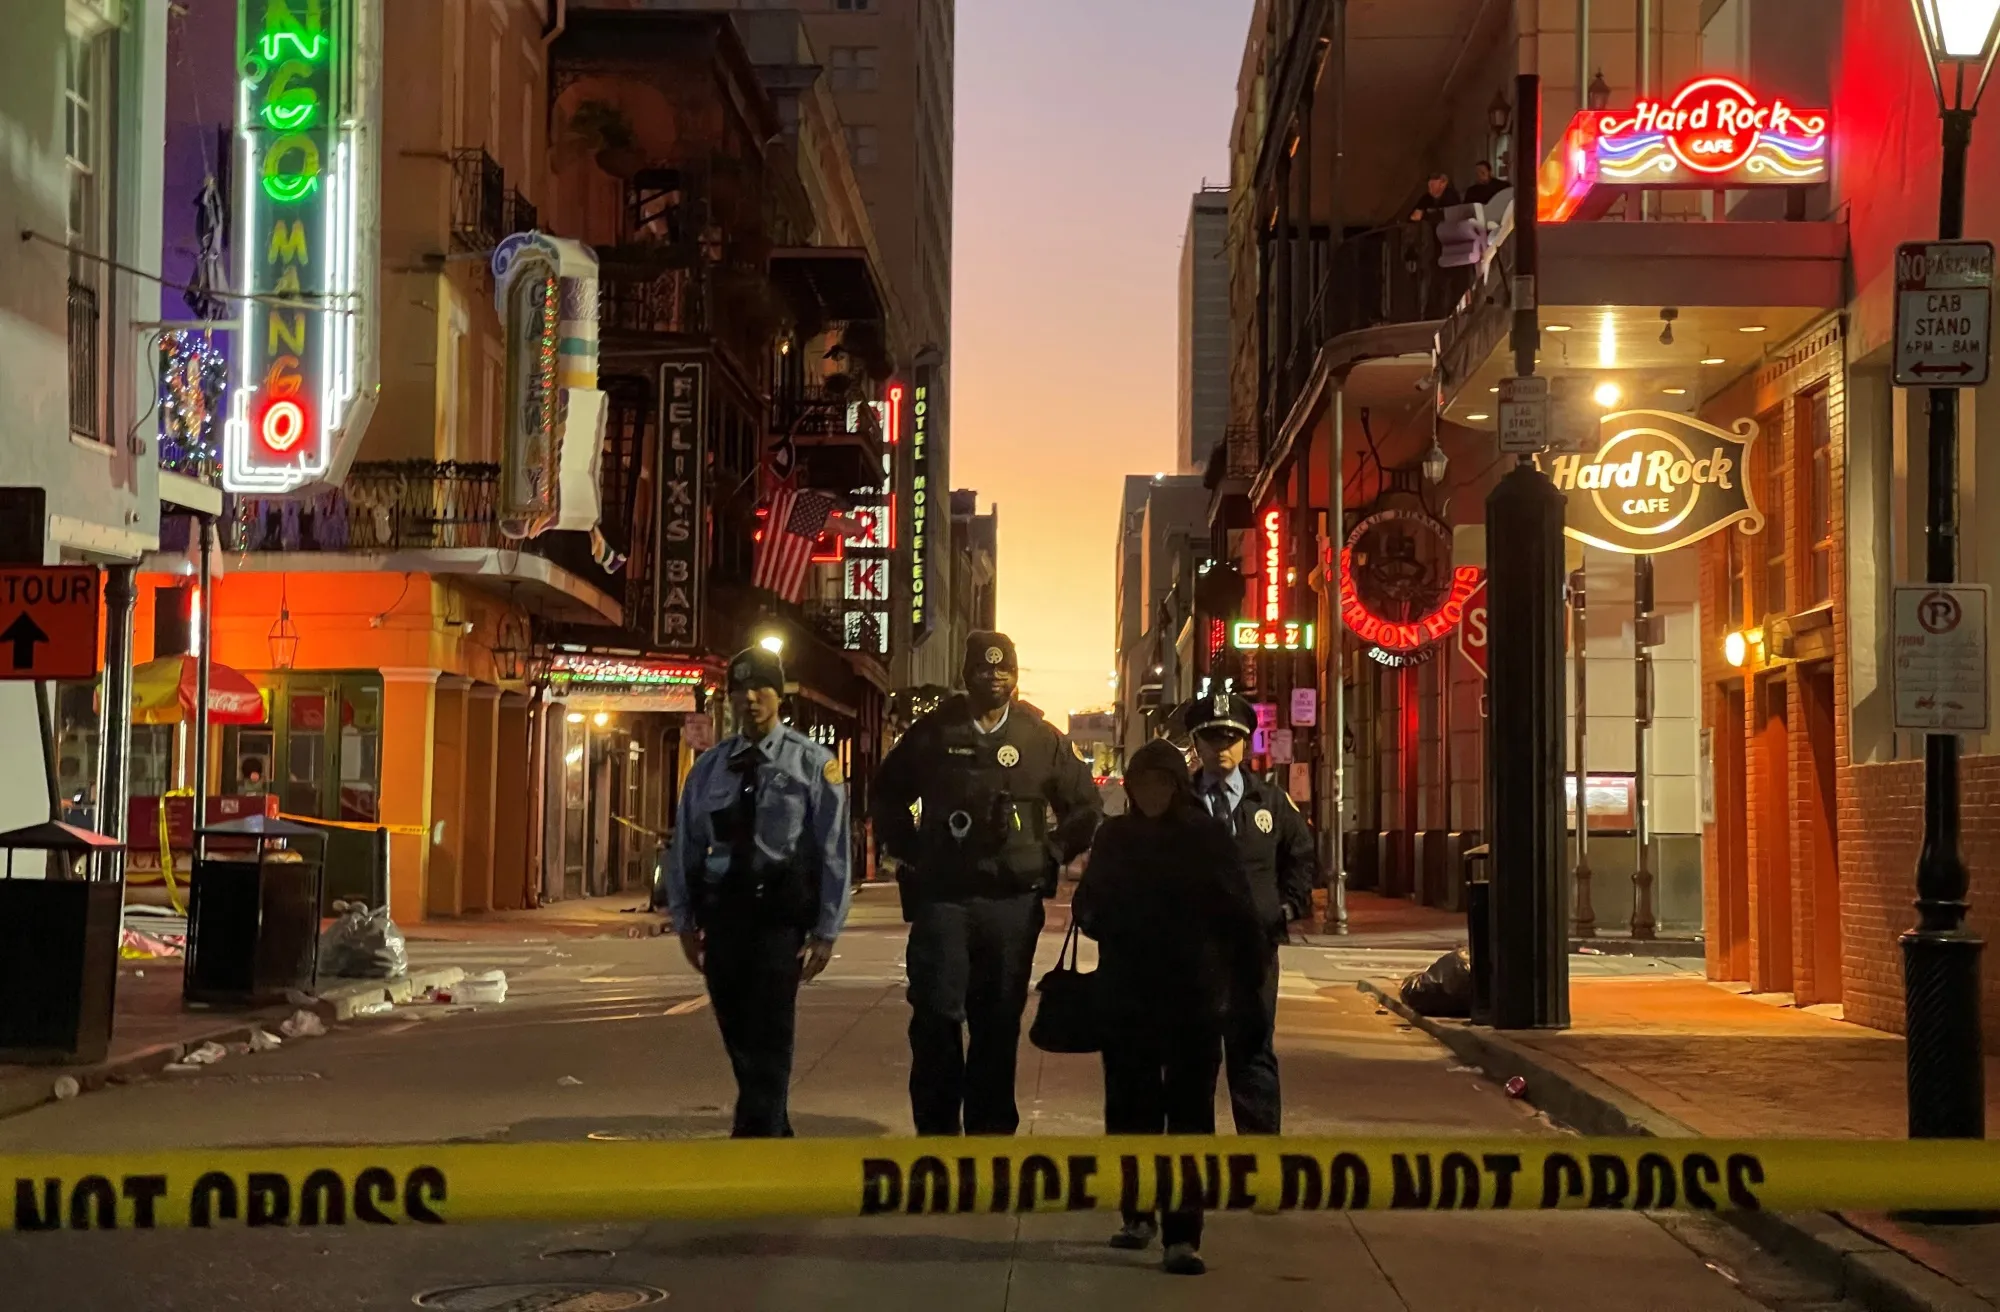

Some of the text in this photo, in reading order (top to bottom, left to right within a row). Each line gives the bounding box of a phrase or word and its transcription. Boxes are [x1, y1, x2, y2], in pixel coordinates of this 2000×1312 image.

[1634, 98, 1793, 136] Hard Rock
[1691, 138, 1734, 154] CAFE
[1899, 252, 1991, 282] NO PARKING
[1926, 294, 1962, 313] CAB
[262, 219, 309, 451] MANGO
[1914, 317, 1972, 336] STAND
[1905, 340, 1934, 354] 6PM
[1951, 339, 1981, 354] 8AM
[1551, 447, 1734, 494] Hard Rock
[663, 377, 693, 636] FELIX'S BAR
[911, 386, 927, 625] HOTEL MONTELEONE
[1622, 497, 1670, 515] CAFE
[1, 575, 92, 604] TOUR
[1422, 565, 1479, 640] HOUS
[1367, 646, 1437, 668] SEAFOOD
[15, 1164, 448, 1230] NOT CROSS
[859, 1152, 1765, 1215] POLICE LINE DO NOT CROSS
